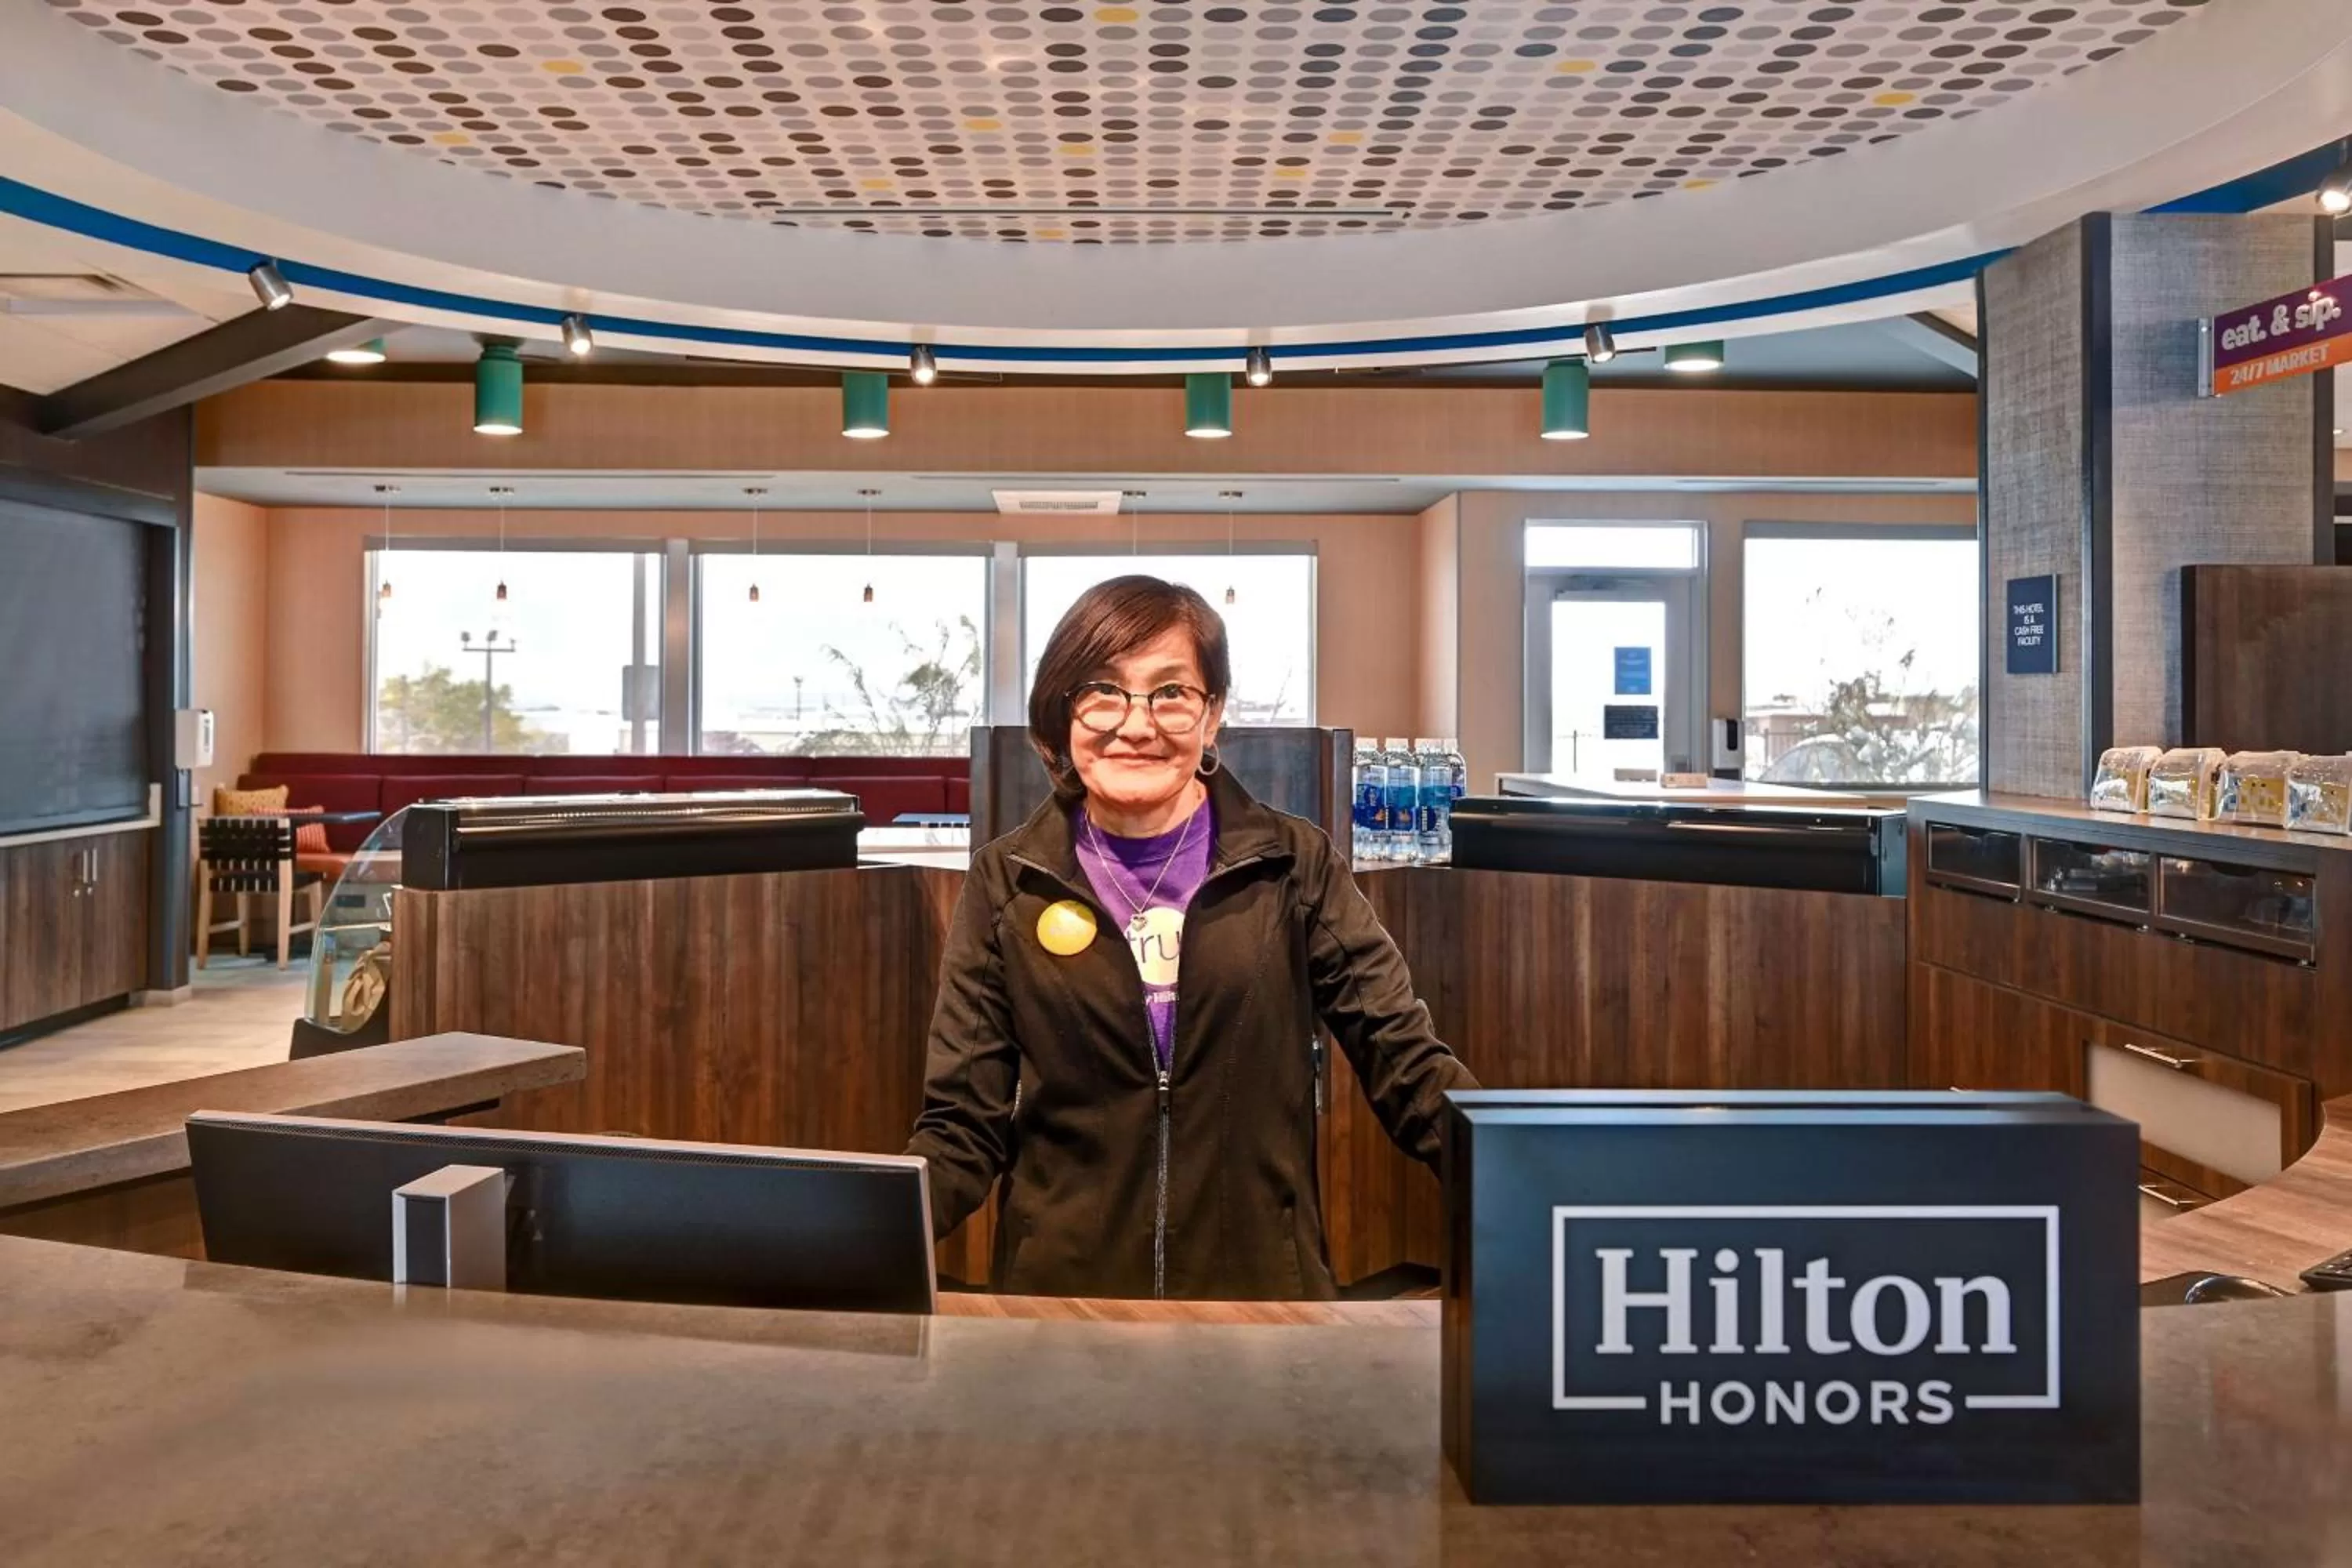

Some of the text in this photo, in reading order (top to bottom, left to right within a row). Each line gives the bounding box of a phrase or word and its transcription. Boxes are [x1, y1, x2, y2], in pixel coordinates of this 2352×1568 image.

[2270, 304, 2290, 336] &
[2296, 291, 2342, 331] sip.
[2230, 343, 2330, 385] 24/7 MARKET
[2015, 625, 2044, 636] CASH FREE
[2017, 637, 2042, 647] FACILITY
[1595, 1248, 2017, 1356] Hilton
[1660, 1381, 1954, 1425] HONORS
